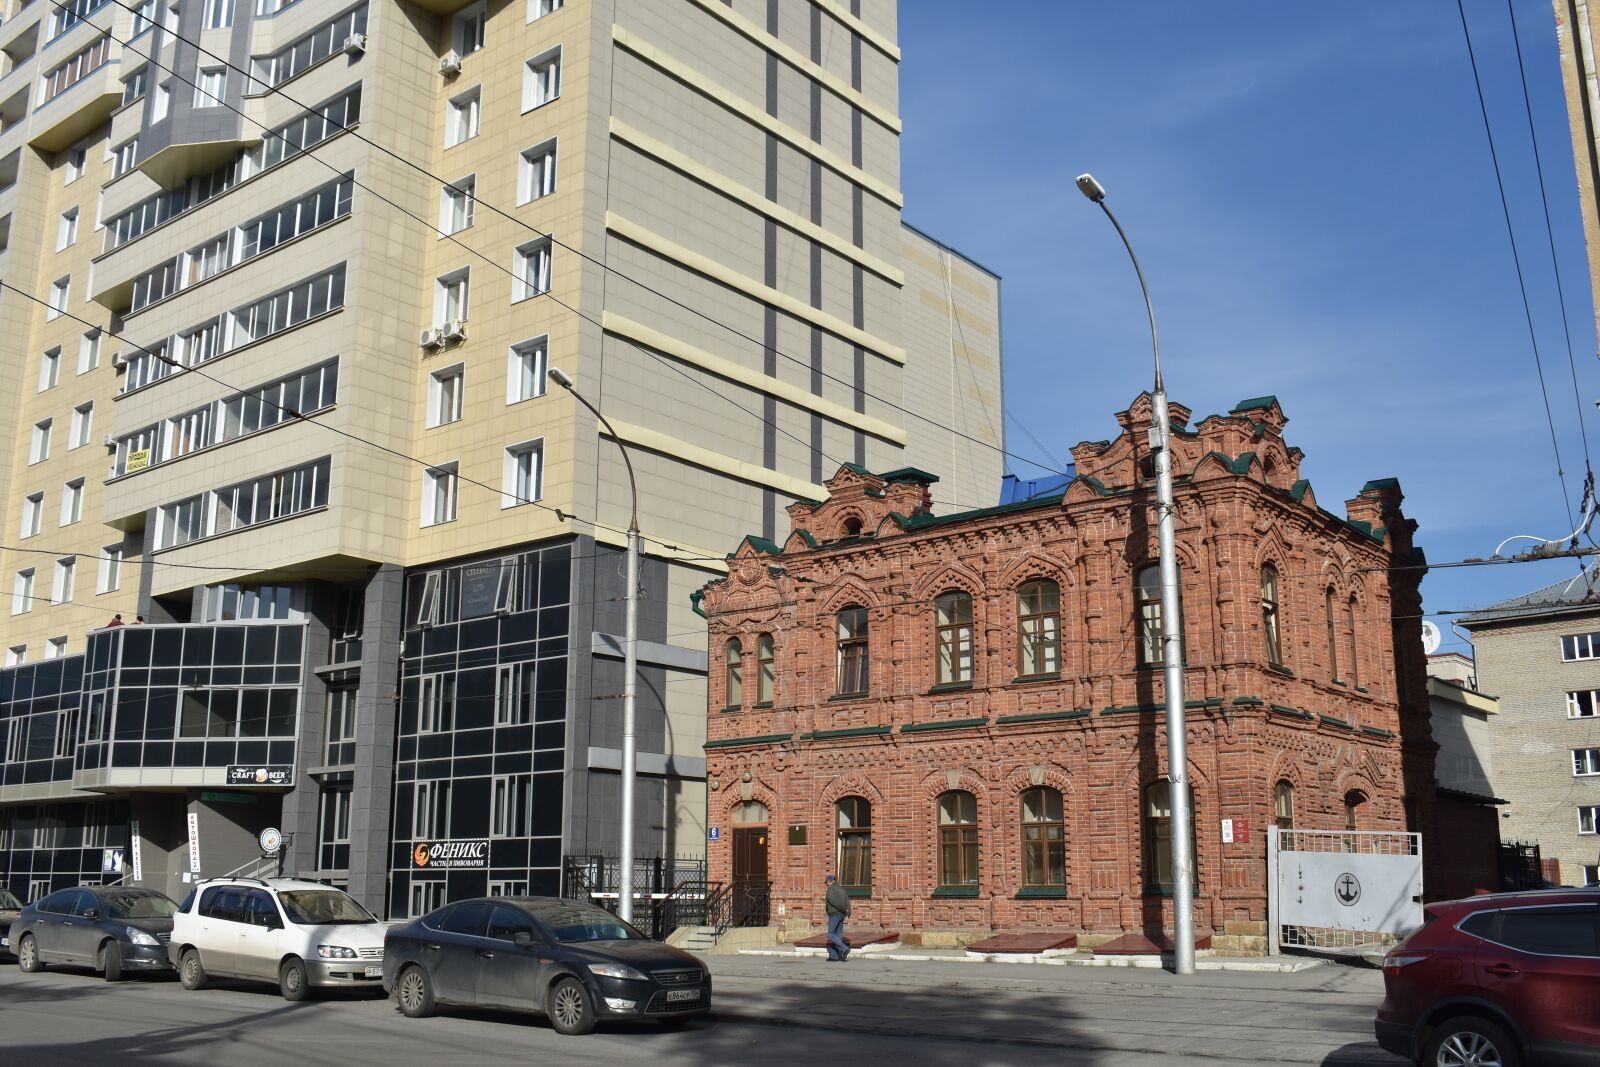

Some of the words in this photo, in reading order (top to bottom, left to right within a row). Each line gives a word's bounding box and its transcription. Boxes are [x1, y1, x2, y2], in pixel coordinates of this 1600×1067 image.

[231, 771, 255, 779] CRAFT
[268, 771, 286, 779] BEER
[711, 827, 717, 836] 6
[430, 842, 487, 858] ФЕНИКС
